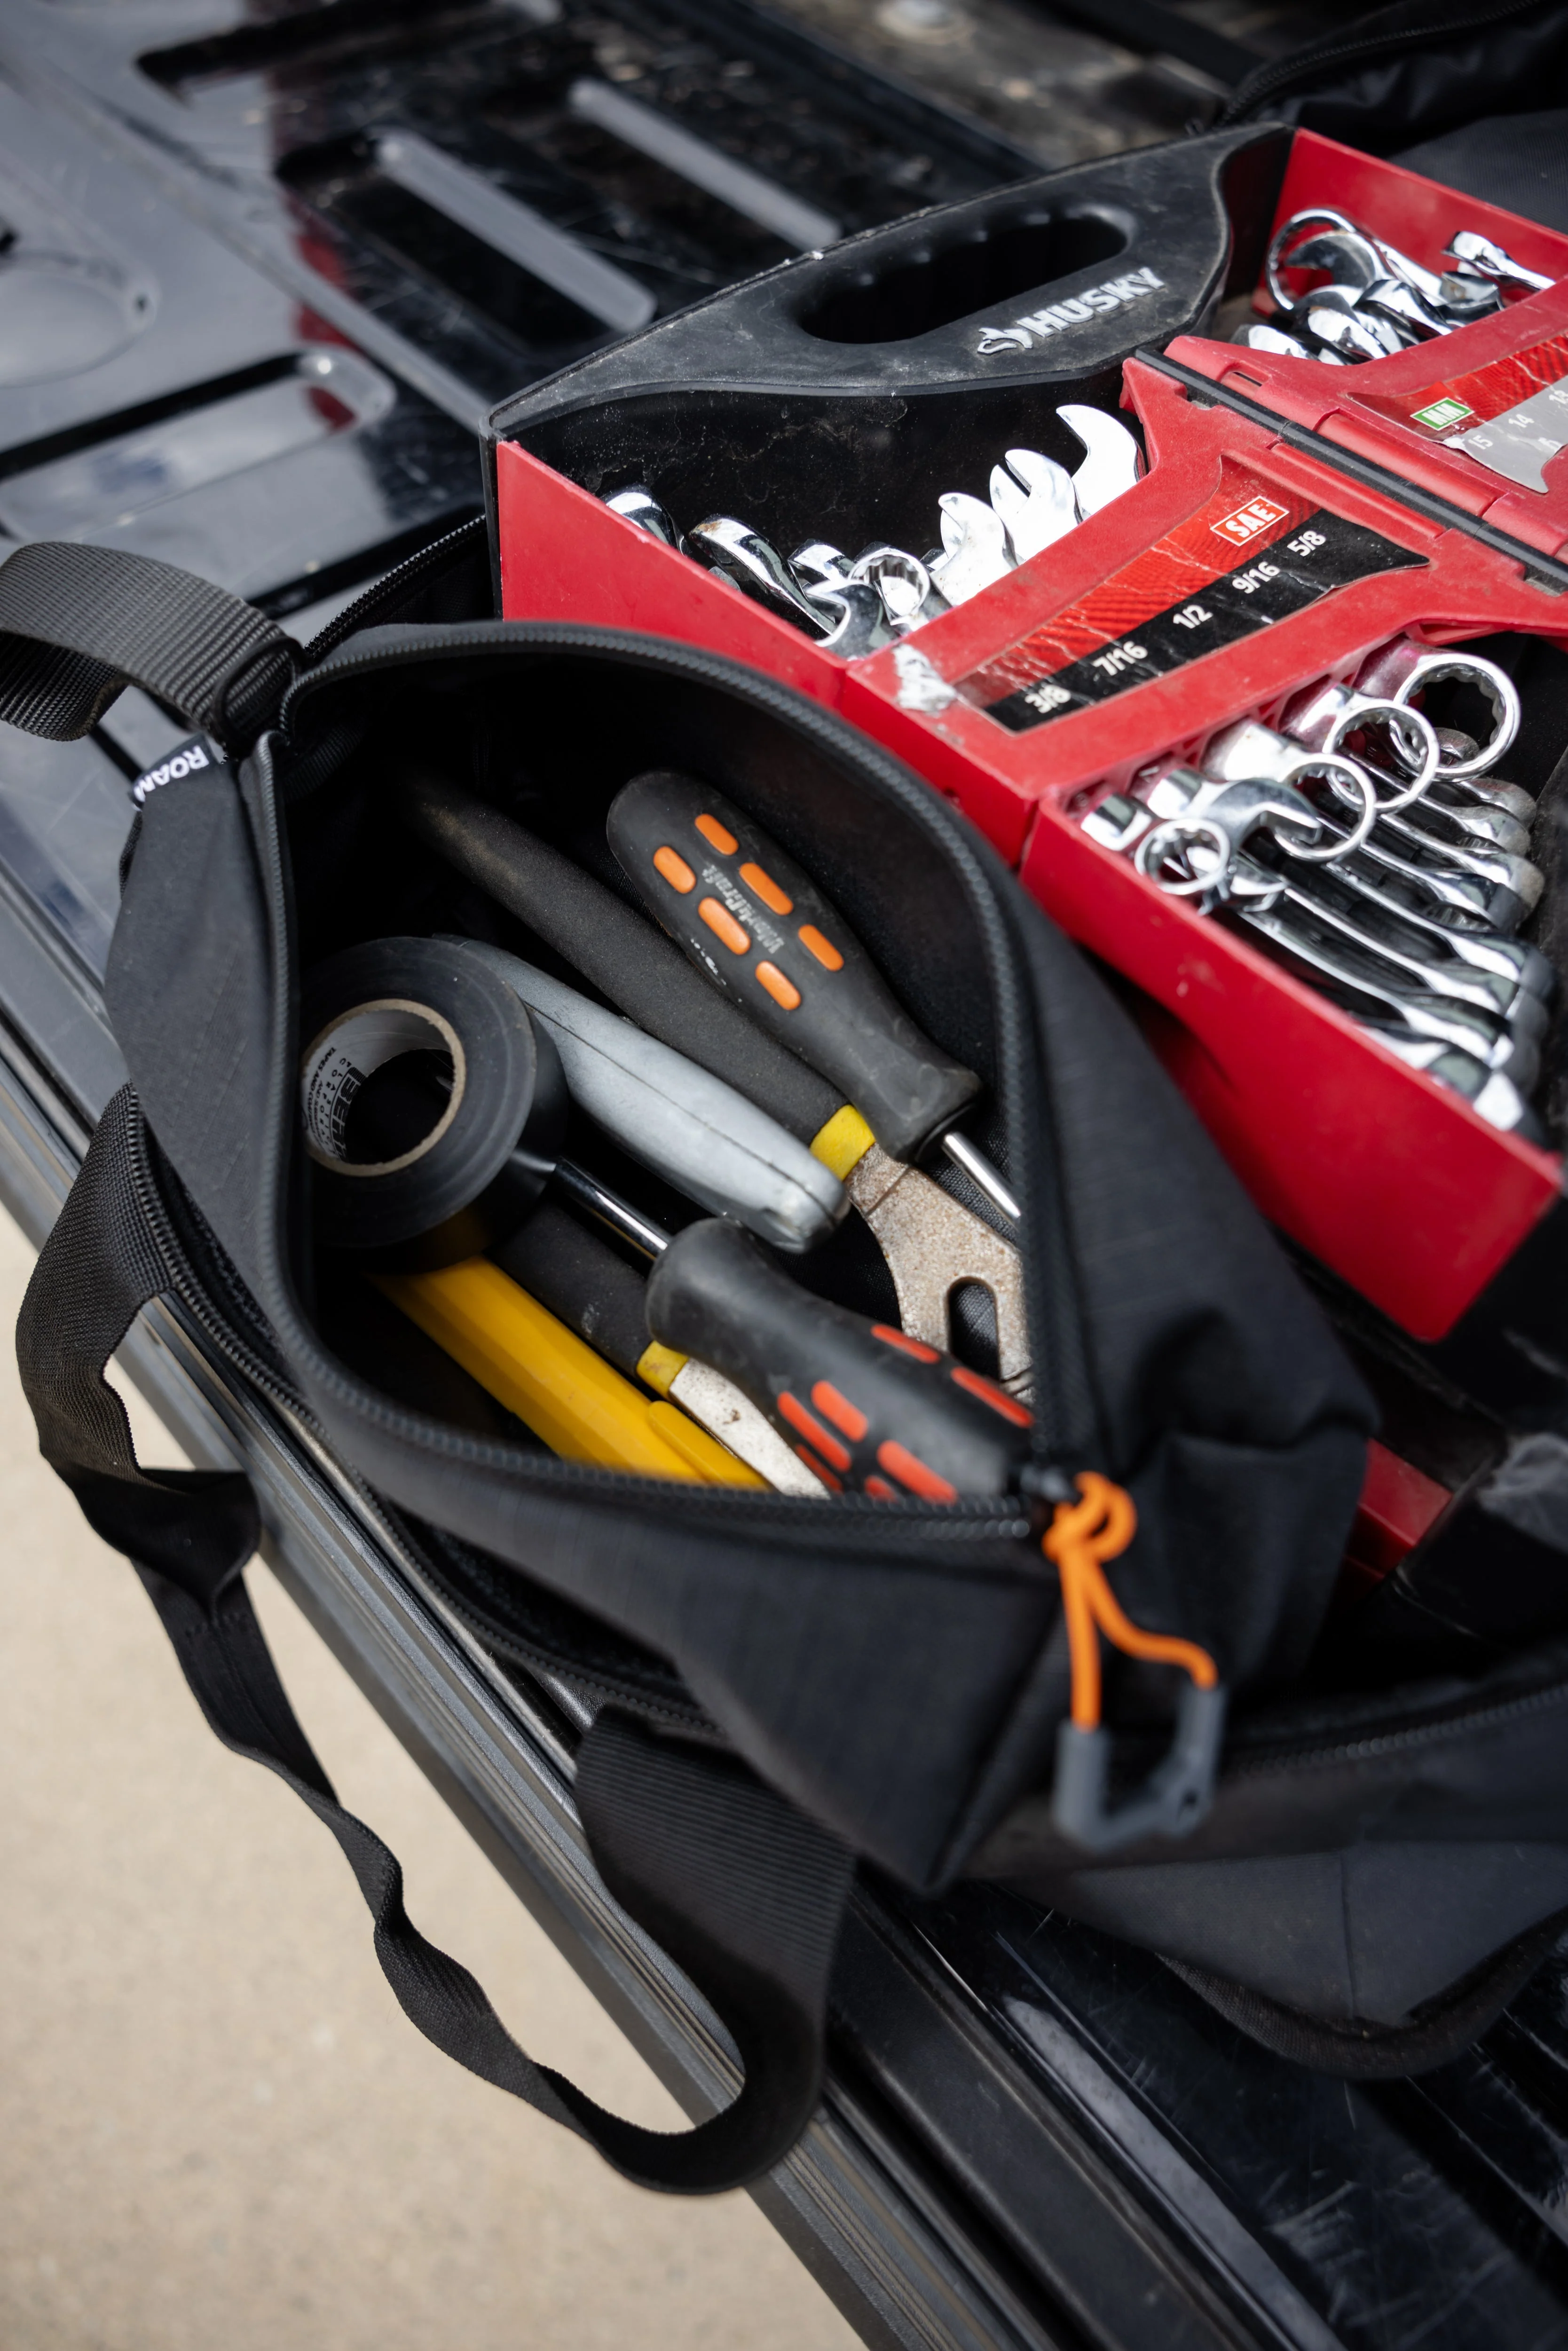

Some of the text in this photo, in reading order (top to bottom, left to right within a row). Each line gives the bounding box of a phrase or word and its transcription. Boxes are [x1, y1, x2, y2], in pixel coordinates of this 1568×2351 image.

[1016, 267, 1165, 337] HUSKY
[1421, 402, 1466, 426] MM
[1469, 435, 1494, 450] 15
[1508, 414, 1535, 428] 14
[1225, 504, 1276, 538] SAE
[1025, 530, 1326, 713] 3/8 7/16 1/2 9/16 5/8
[133, 745, 210, 803] ROAM
[317, 1047, 337, 1073] TAPES
